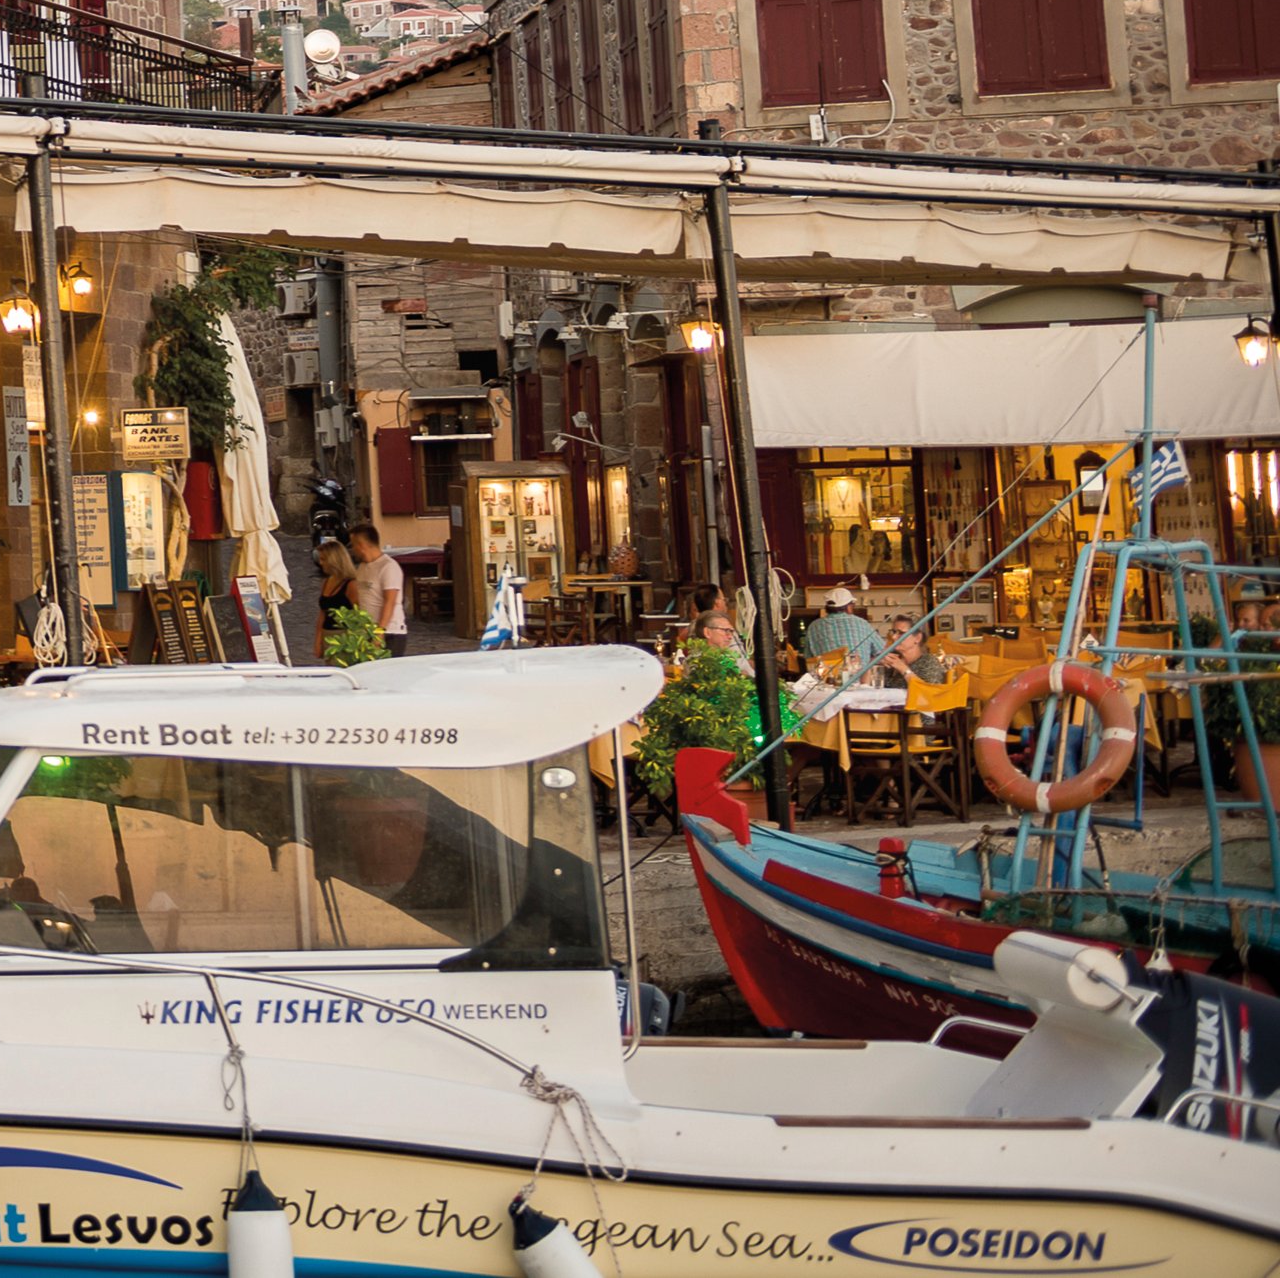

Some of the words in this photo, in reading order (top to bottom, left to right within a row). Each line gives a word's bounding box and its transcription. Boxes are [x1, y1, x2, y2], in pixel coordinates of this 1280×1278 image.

[11, 421, 25, 435] Sea
[139, 435, 180, 443] RATES
[8, 436, 28, 452] Horse
[82, 723, 149, 745] Rent
[159, 723, 232, 746] Boat
[244, 726, 275, 745] tel:
[280, 728, 319, 745] +30
[325, 728, 388, 745] 22530
[394, 728, 458, 744] 41898
[160, 1000, 242, 1025] KING
[256, 1000, 365, 1024] FISHER
[376, 999, 436, 1023] 650
[443, 1003, 548, 1020] WEEKEND
[1186, 999, 1222, 1131] SUZUKI
[38, 1202, 215, 1248] Lesvos
[221, 1188, 408, 1234] Eplore
[416, 1199, 503, 1241] the
[557, 1217, 710, 1258] gean
[902, 1228, 1108, 1262] POSEIDON
